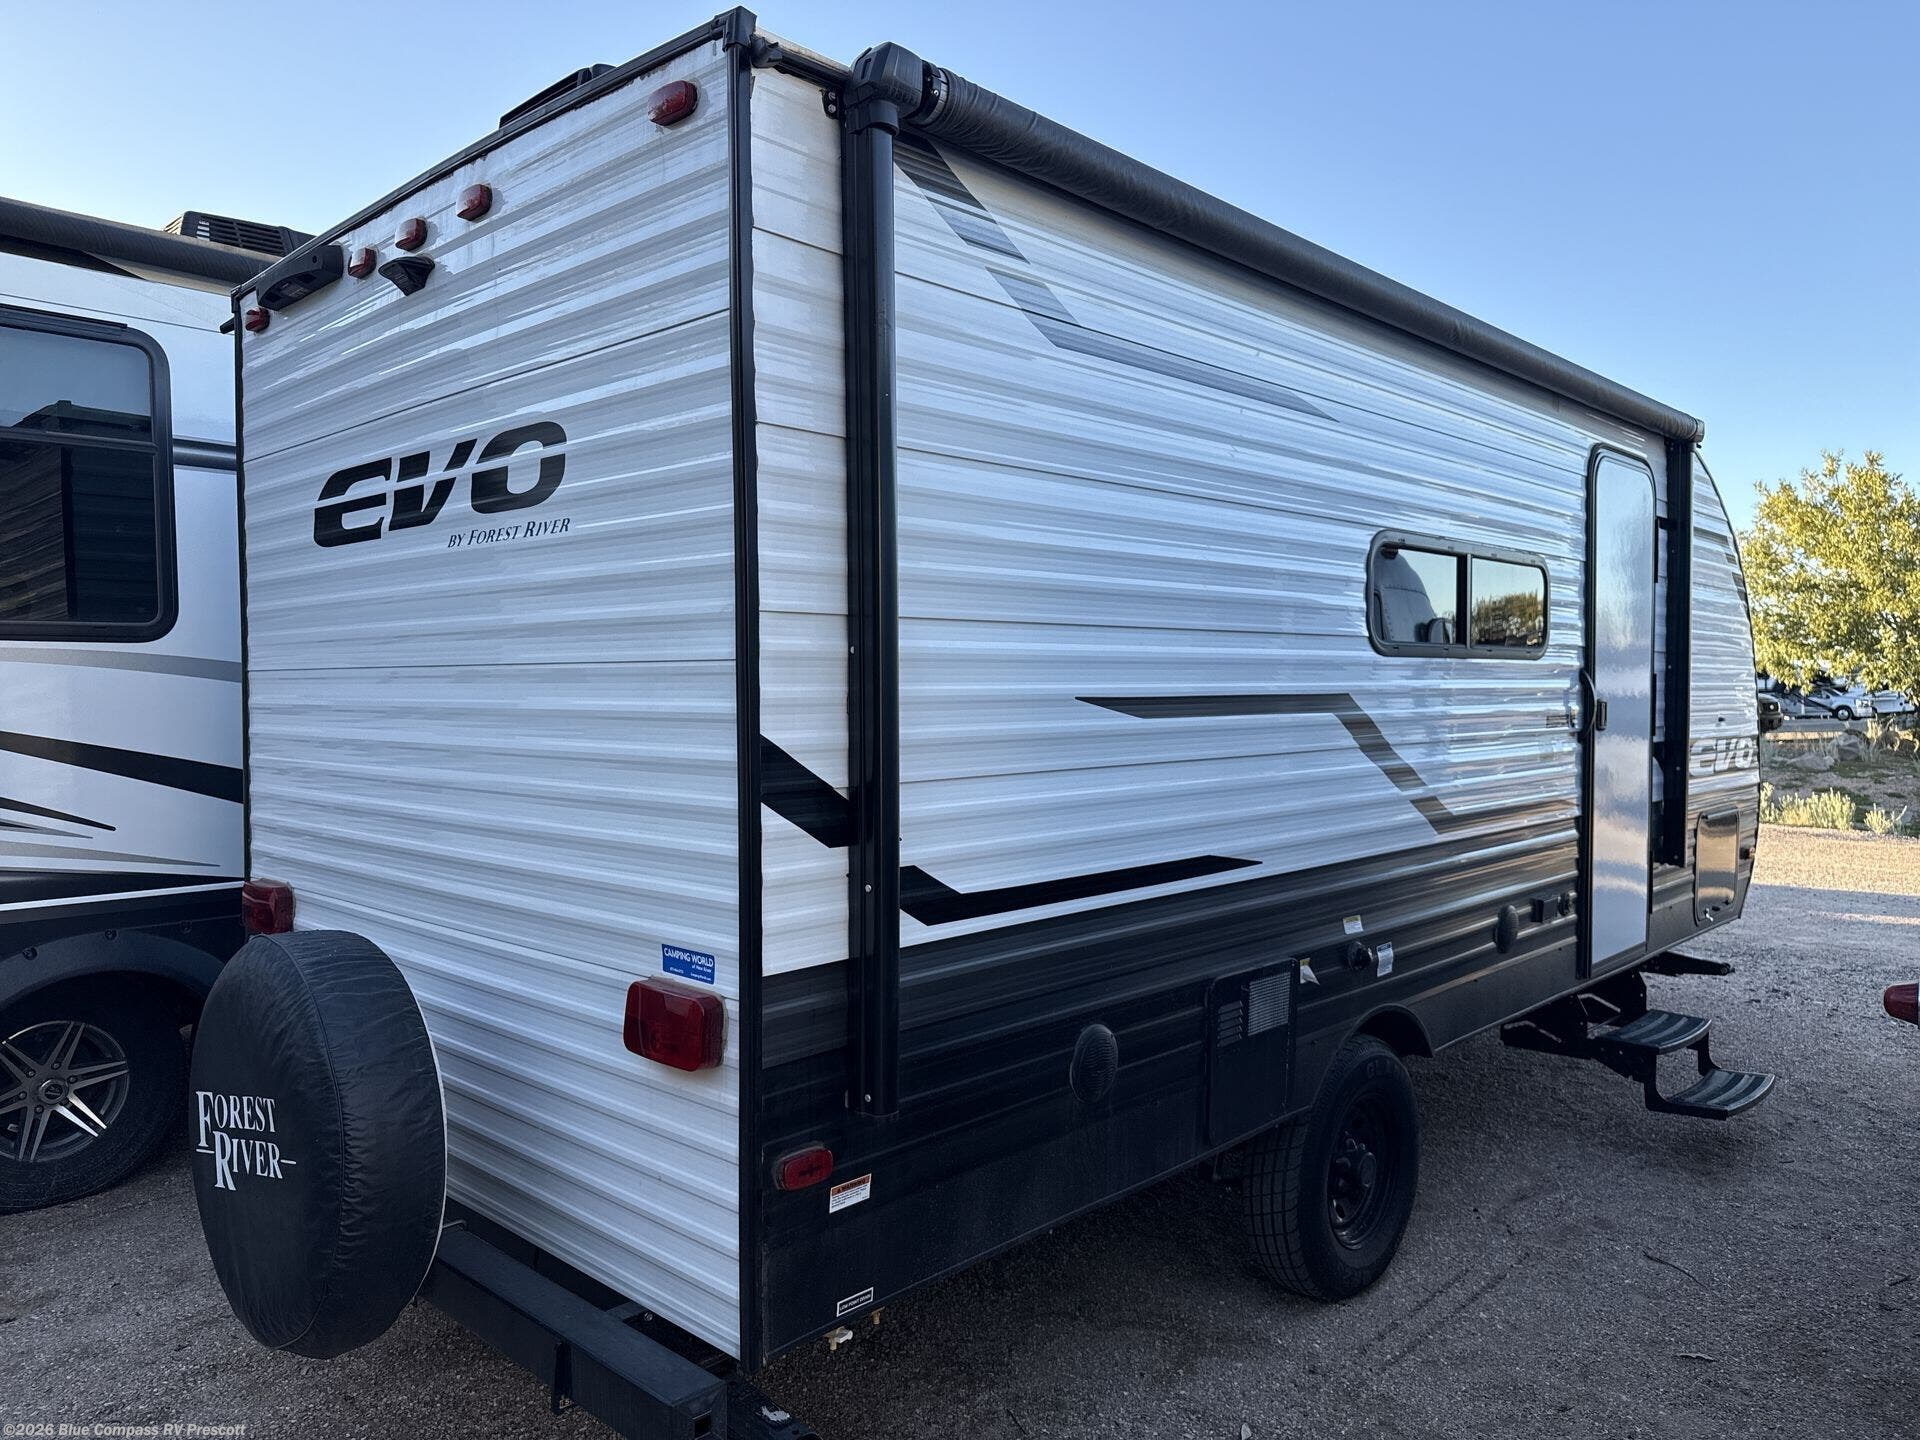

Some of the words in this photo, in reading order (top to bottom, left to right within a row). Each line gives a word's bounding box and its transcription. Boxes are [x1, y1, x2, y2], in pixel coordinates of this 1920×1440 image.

[313, 421, 568, 548] EVO
[447, 533, 466, 548] BY
[467, 524, 522, 546] FOREST
[523, 517, 571, 538] RIVER
[1688, 737, 1754, 777] EVO
[663, 947, 690, 962] CAMPING
[690, 953, 714, 967] WORLD
[196, 1091, 276, 1147] FOREST
[213, 1131, 283, 1191] RIVER
